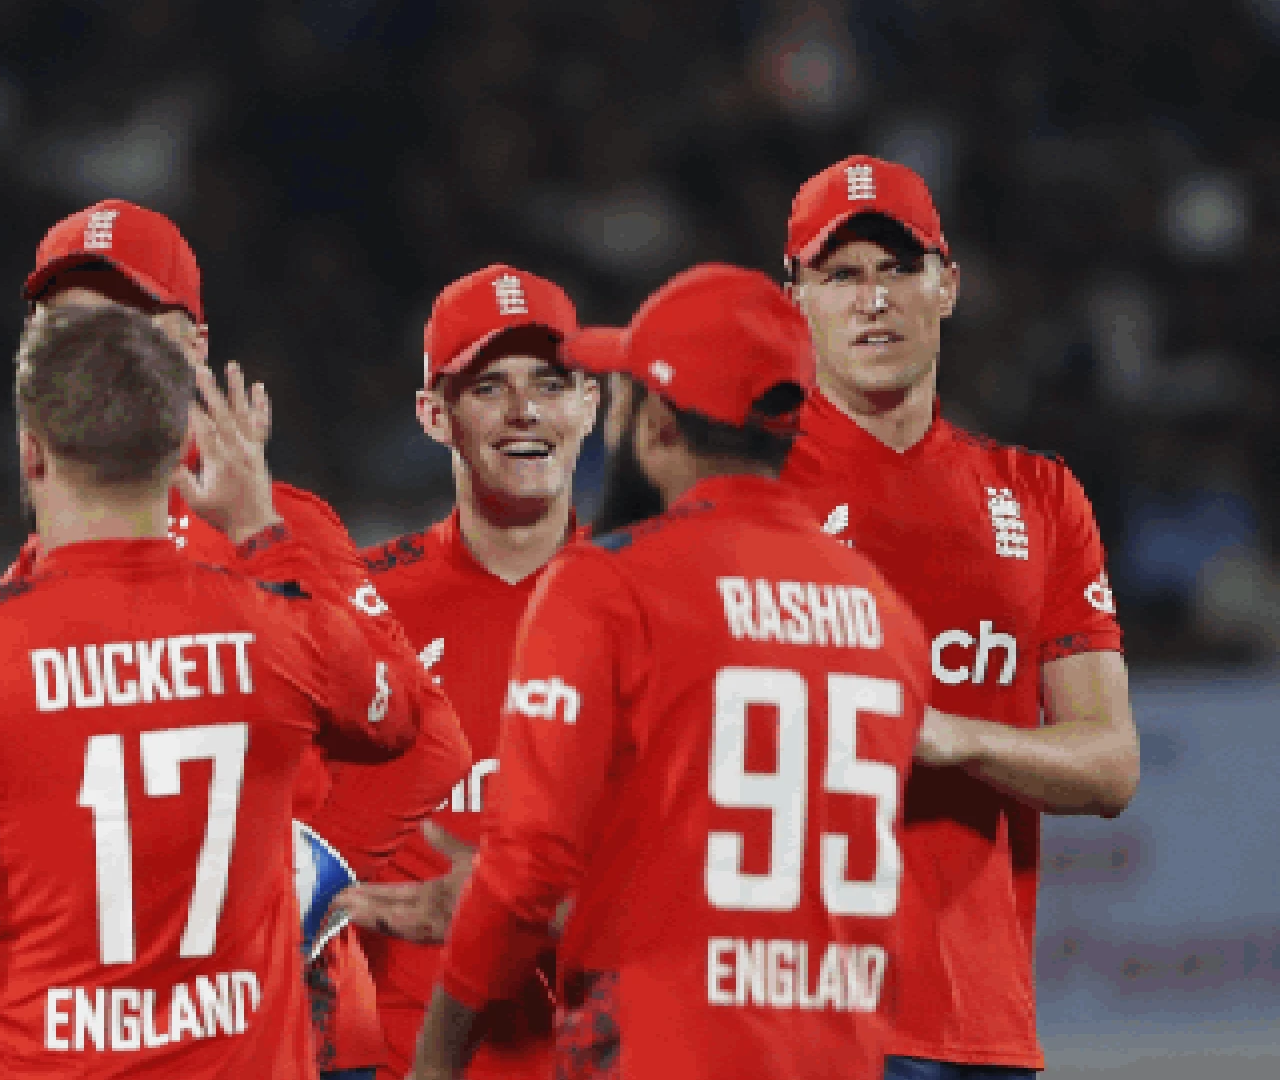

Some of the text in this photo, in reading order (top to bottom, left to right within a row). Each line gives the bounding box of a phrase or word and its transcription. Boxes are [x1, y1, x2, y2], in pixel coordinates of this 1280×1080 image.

[717, 576, 883, 649] RASHID
[30, 632, 255, 712] DUCKETT
[704, 666, 903, 917] 95
[77, 722, 248, 965] 17
[44, 970, 262, 1052] ENGLAND
[706, 936, 887, 1012] ENGLAND
